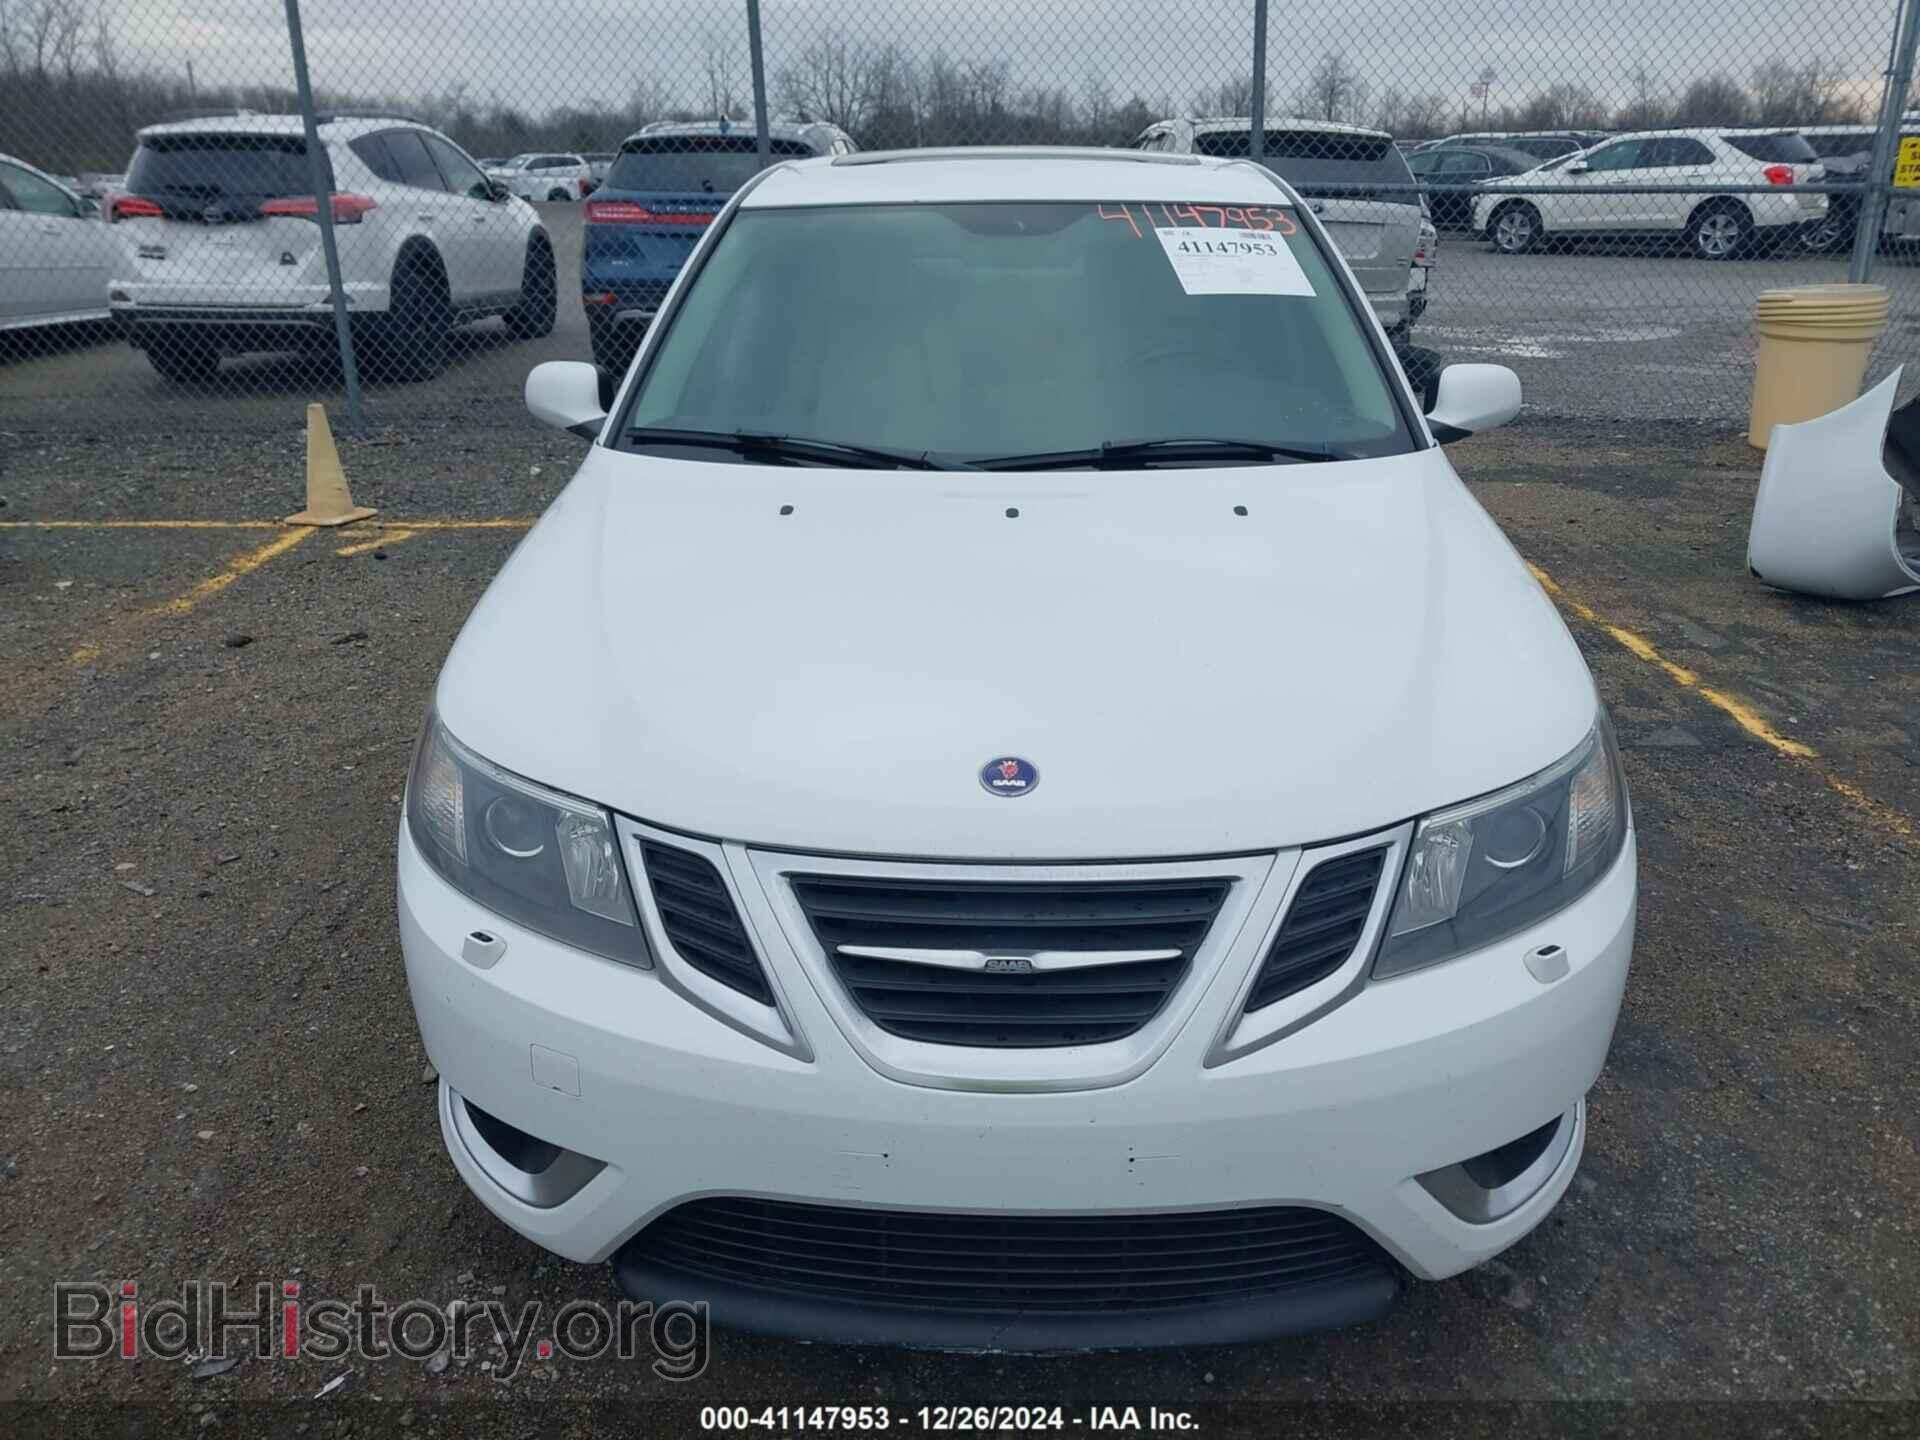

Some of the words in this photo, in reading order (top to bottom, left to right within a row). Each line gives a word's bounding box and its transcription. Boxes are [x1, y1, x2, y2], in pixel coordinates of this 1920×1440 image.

[1097, 203, 1297, 239] 41147953
[1178, 241, 1278, 256] 41147953
[987, 960, 1031, 971] SAAB
